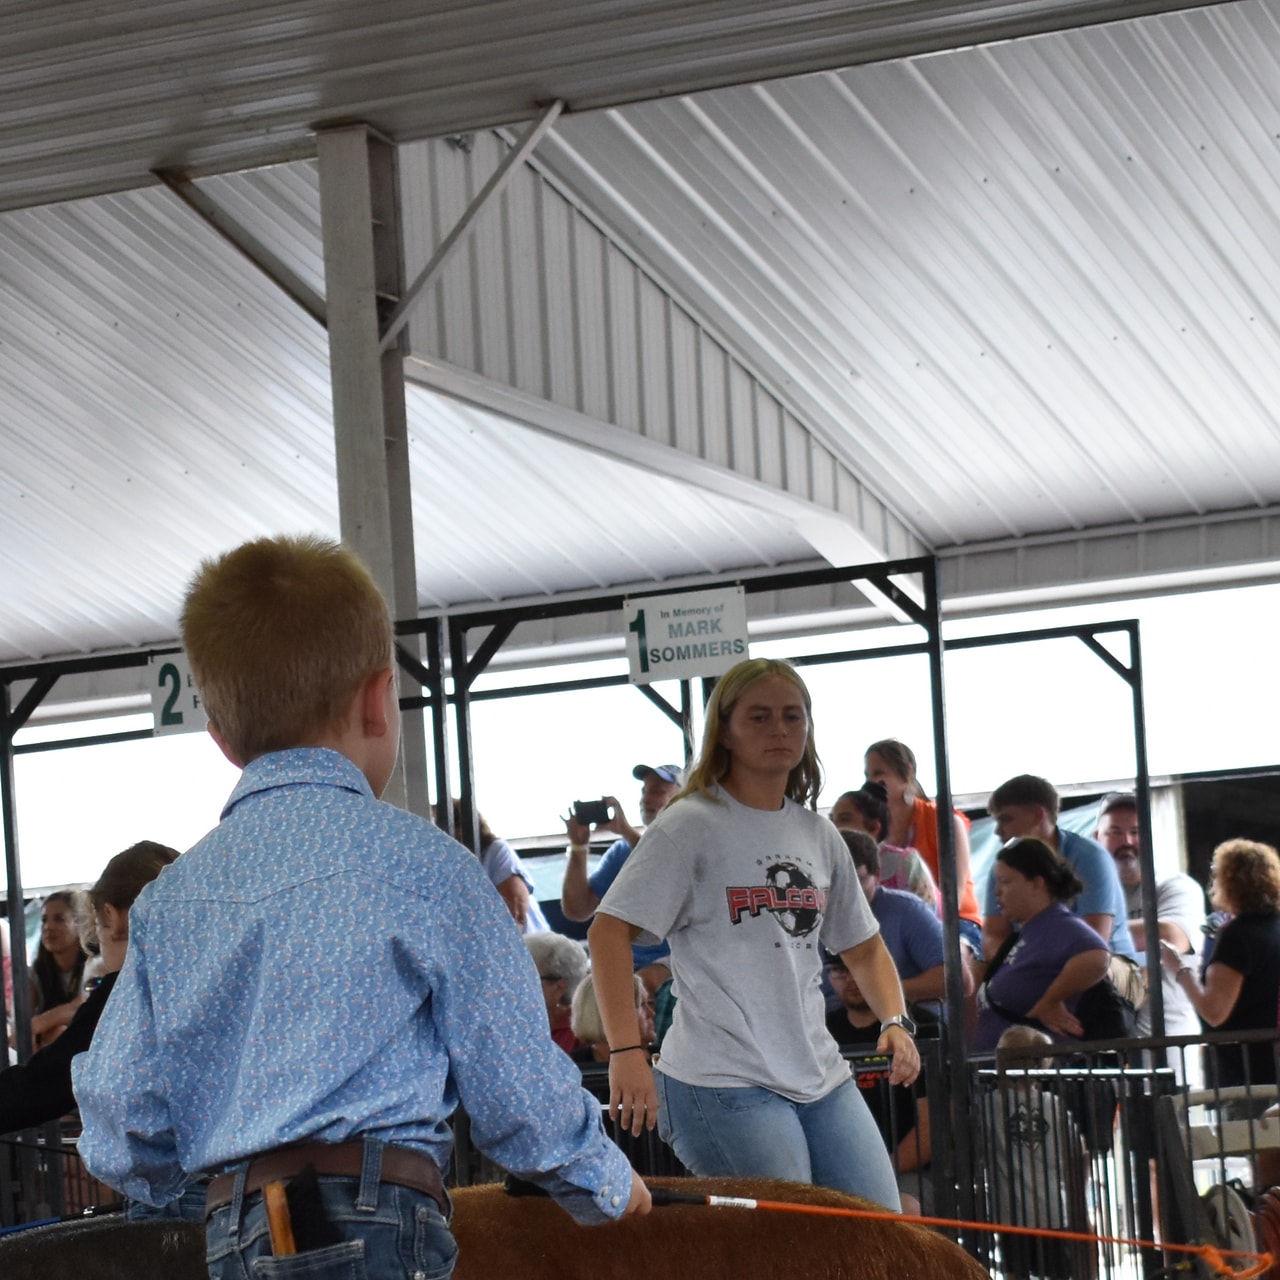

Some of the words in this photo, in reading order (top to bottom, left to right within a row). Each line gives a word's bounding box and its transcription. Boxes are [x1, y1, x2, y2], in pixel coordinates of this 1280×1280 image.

[660, 610, 670, 619] In
[673, 606, 711, 618] Memory
[713, 603, 725, 614] of
[629, 609, 649, 673] 1
[668, 618, 723, 639] MARK
[650, 638, 745, 664] SOMMERS
[158, 662, 183, 726] 2
